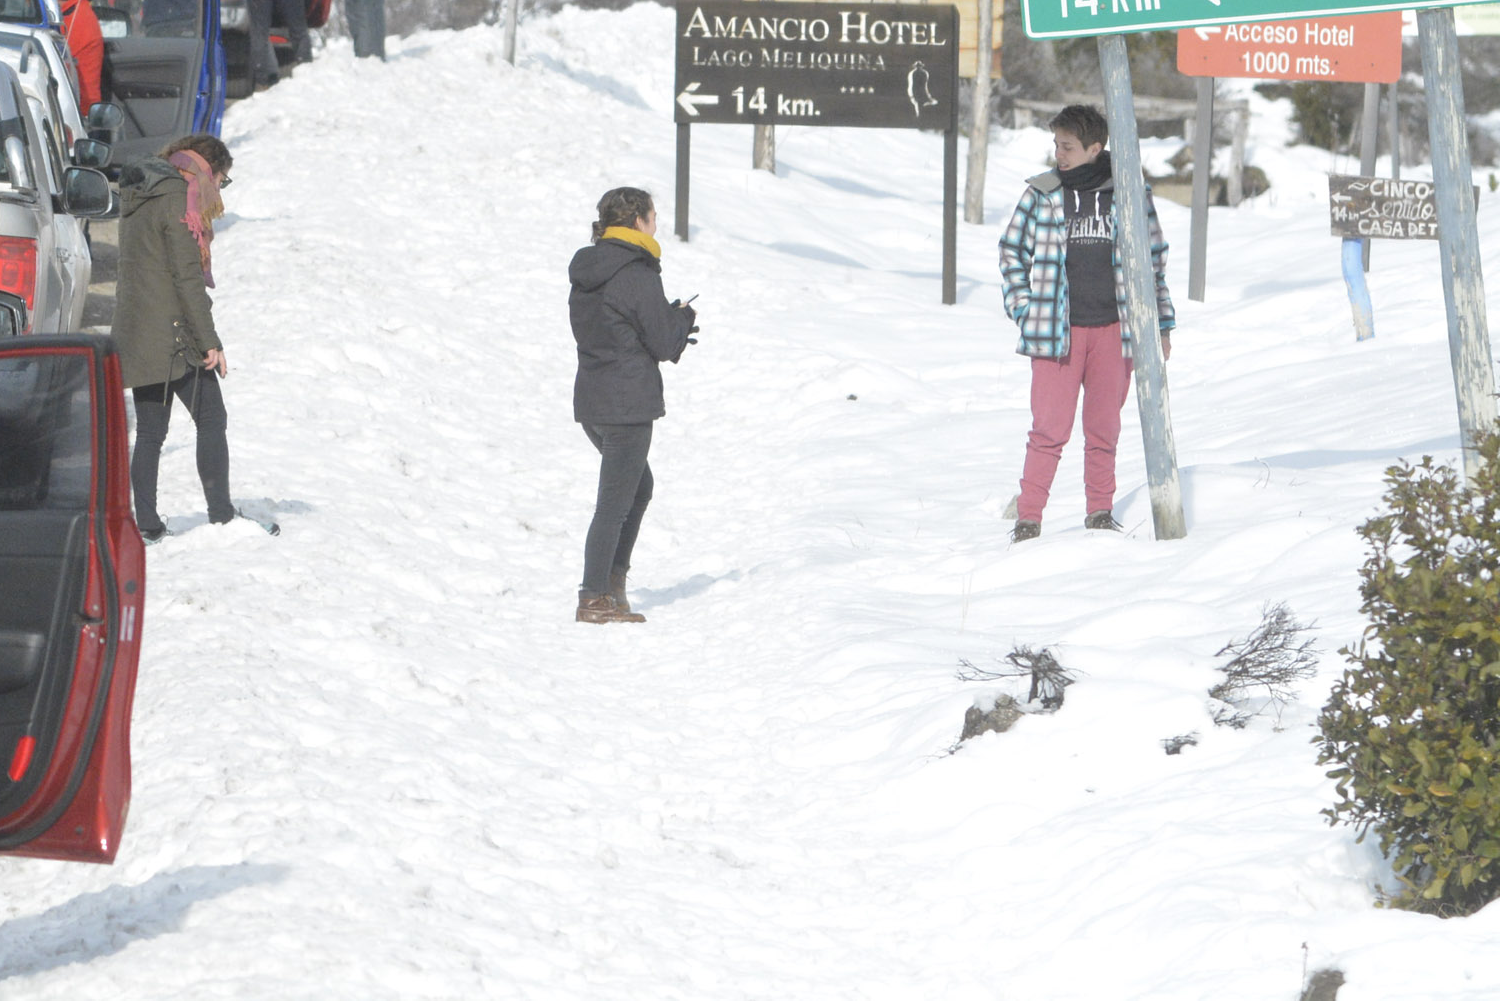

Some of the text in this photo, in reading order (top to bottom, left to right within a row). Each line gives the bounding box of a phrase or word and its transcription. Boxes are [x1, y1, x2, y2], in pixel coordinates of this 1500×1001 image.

[682, 6, 947, 47] AMANCIO HOTEL
[1224, 22, 1355, 47] Acceso Hotel
[692, 46, 887, 72] LAGO MELIQUINA
[1241, 50, 1336, 76] 1000 mts.
[730, 85, 821, 118] 14 km.
[1369, 179, 1430, 200] CINCO
[1357, 219, 1405, 238] CASA
